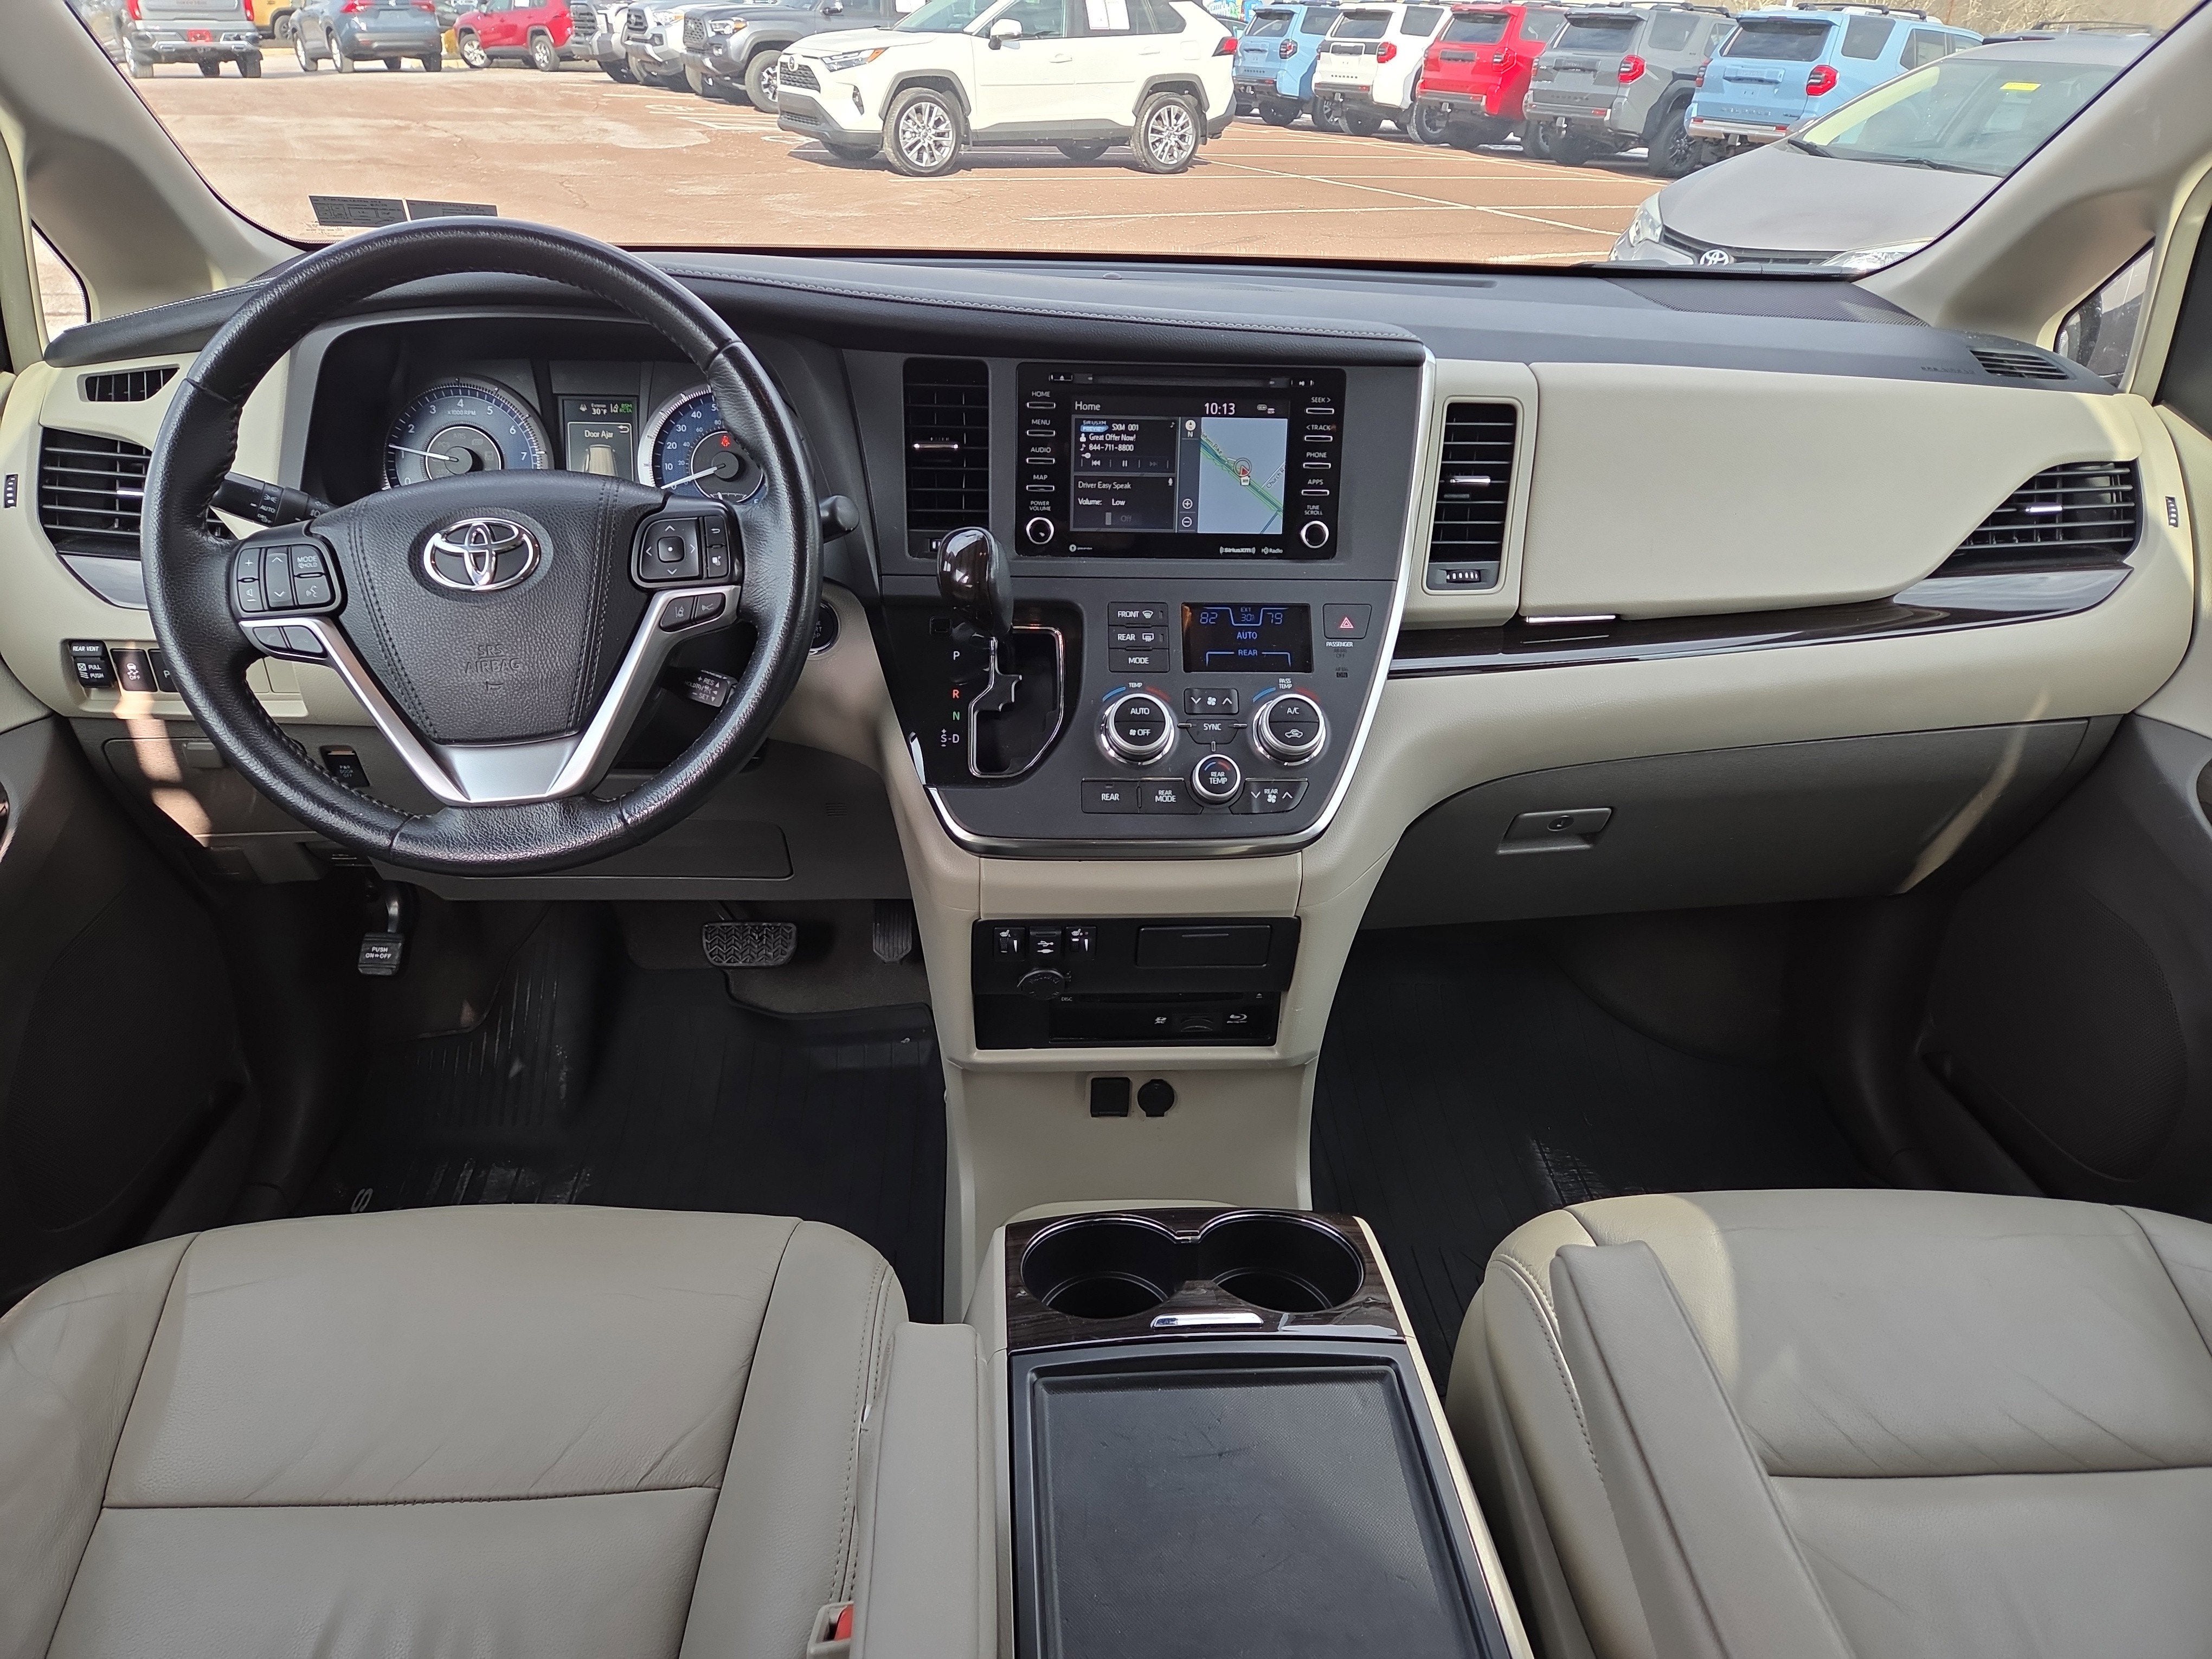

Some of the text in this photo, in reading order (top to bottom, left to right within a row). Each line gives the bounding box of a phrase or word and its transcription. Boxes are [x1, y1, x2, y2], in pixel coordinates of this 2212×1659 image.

[457, 398, 464, 407] 4
[1075, 401, 1101, 411] Home
[429, 404, 436, 414] 3
[487, 406, 493, 415] 5
[1205, 402, 1236, 415] 10:13
[691, 411, 702, 419] 40
[408, 424, 415, 433] 2
[510, 426, 516, 435] 6
[584, 429, 614, 439] Door Ajar
[520, 452, 528, 461] 7
[665, 462, 673, 471] 10
[1097, 481, 1111, 490] Easy
[1113, 481, 1131, 490] Speak
[1078, 497, 1126, 506] Volume: Low
[260, 505, 275, 513] AUTO
[1200, 612, 1218, 624] 82
[1266, 612, 1283, 625] 79
[1237, 631, 1258, 640] AUTO
[478, 644, 504, 655] SRS
[953, 651, 960, 660] P
[1128, 657, 1149, 665] MODE
[465, 659, 523, 674] AIRBAG
[953, 689, 960, 699] R
[953, 711, 960, 721] N
[1203, 723, 1222, 731] SYNC
[1209, 777, 1228, 785] TEMP
[1101, 793, 1120, 801] REAR
[1155, 794, 1176, 802] MODE
